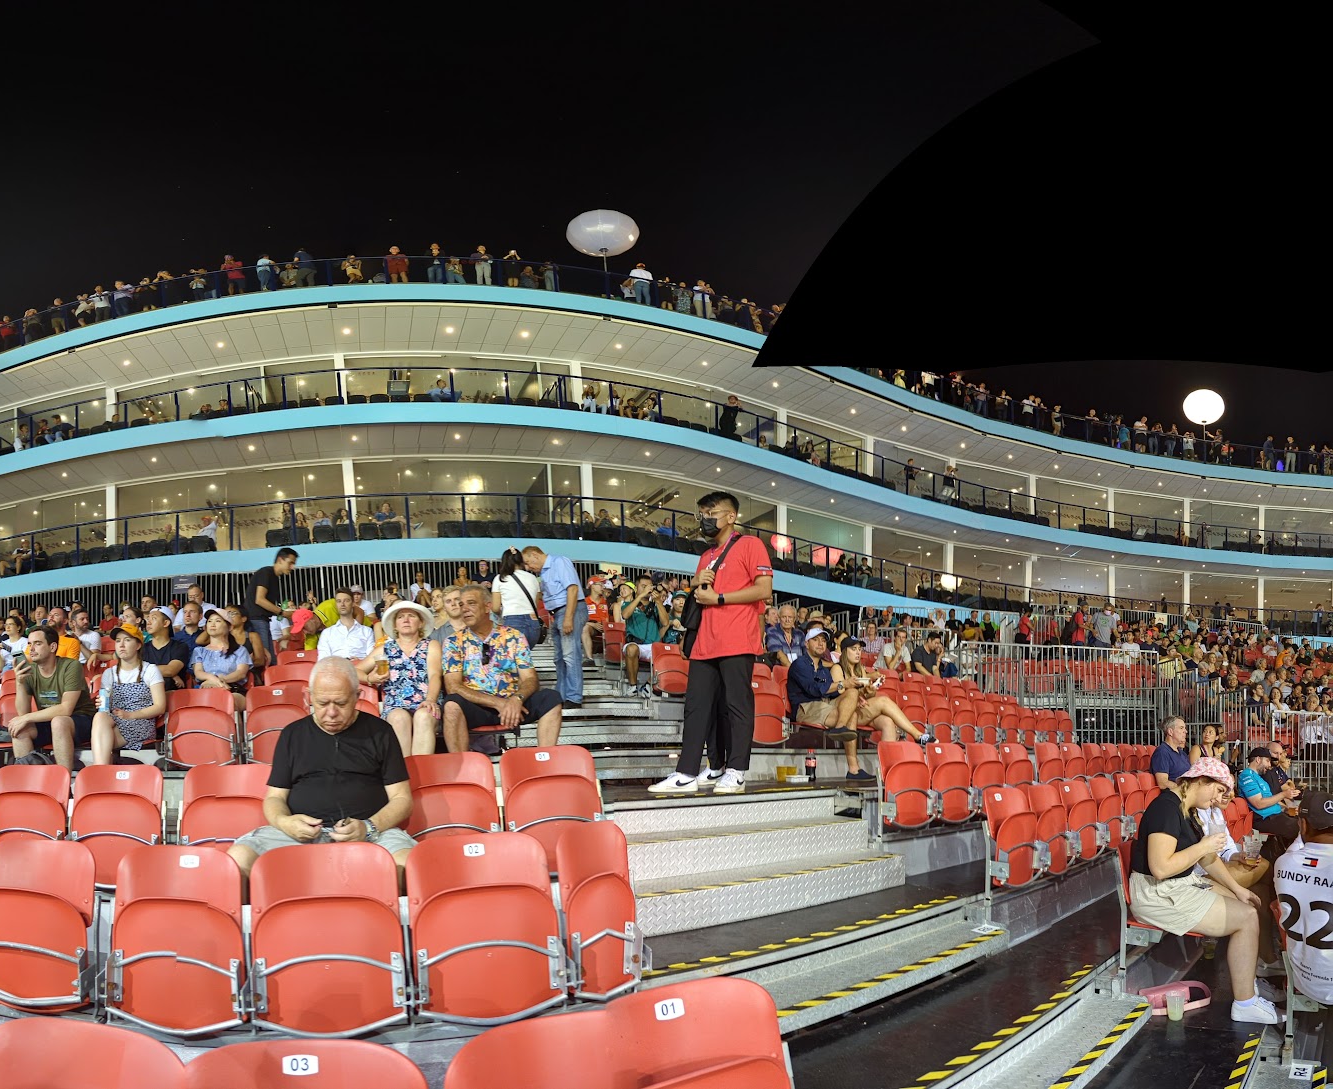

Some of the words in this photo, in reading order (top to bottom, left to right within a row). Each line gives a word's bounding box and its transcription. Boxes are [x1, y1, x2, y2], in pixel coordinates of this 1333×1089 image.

[607, 568, 618, 576] A2
[1276, 868, 1311, 885] BUNDY
[1278, 893, 1333, 950] 22
[660, 1001, 676, 1017] 01
[290, 1057, 310, 1072] 03
[1293, 1067, 1309, 1078] R4
